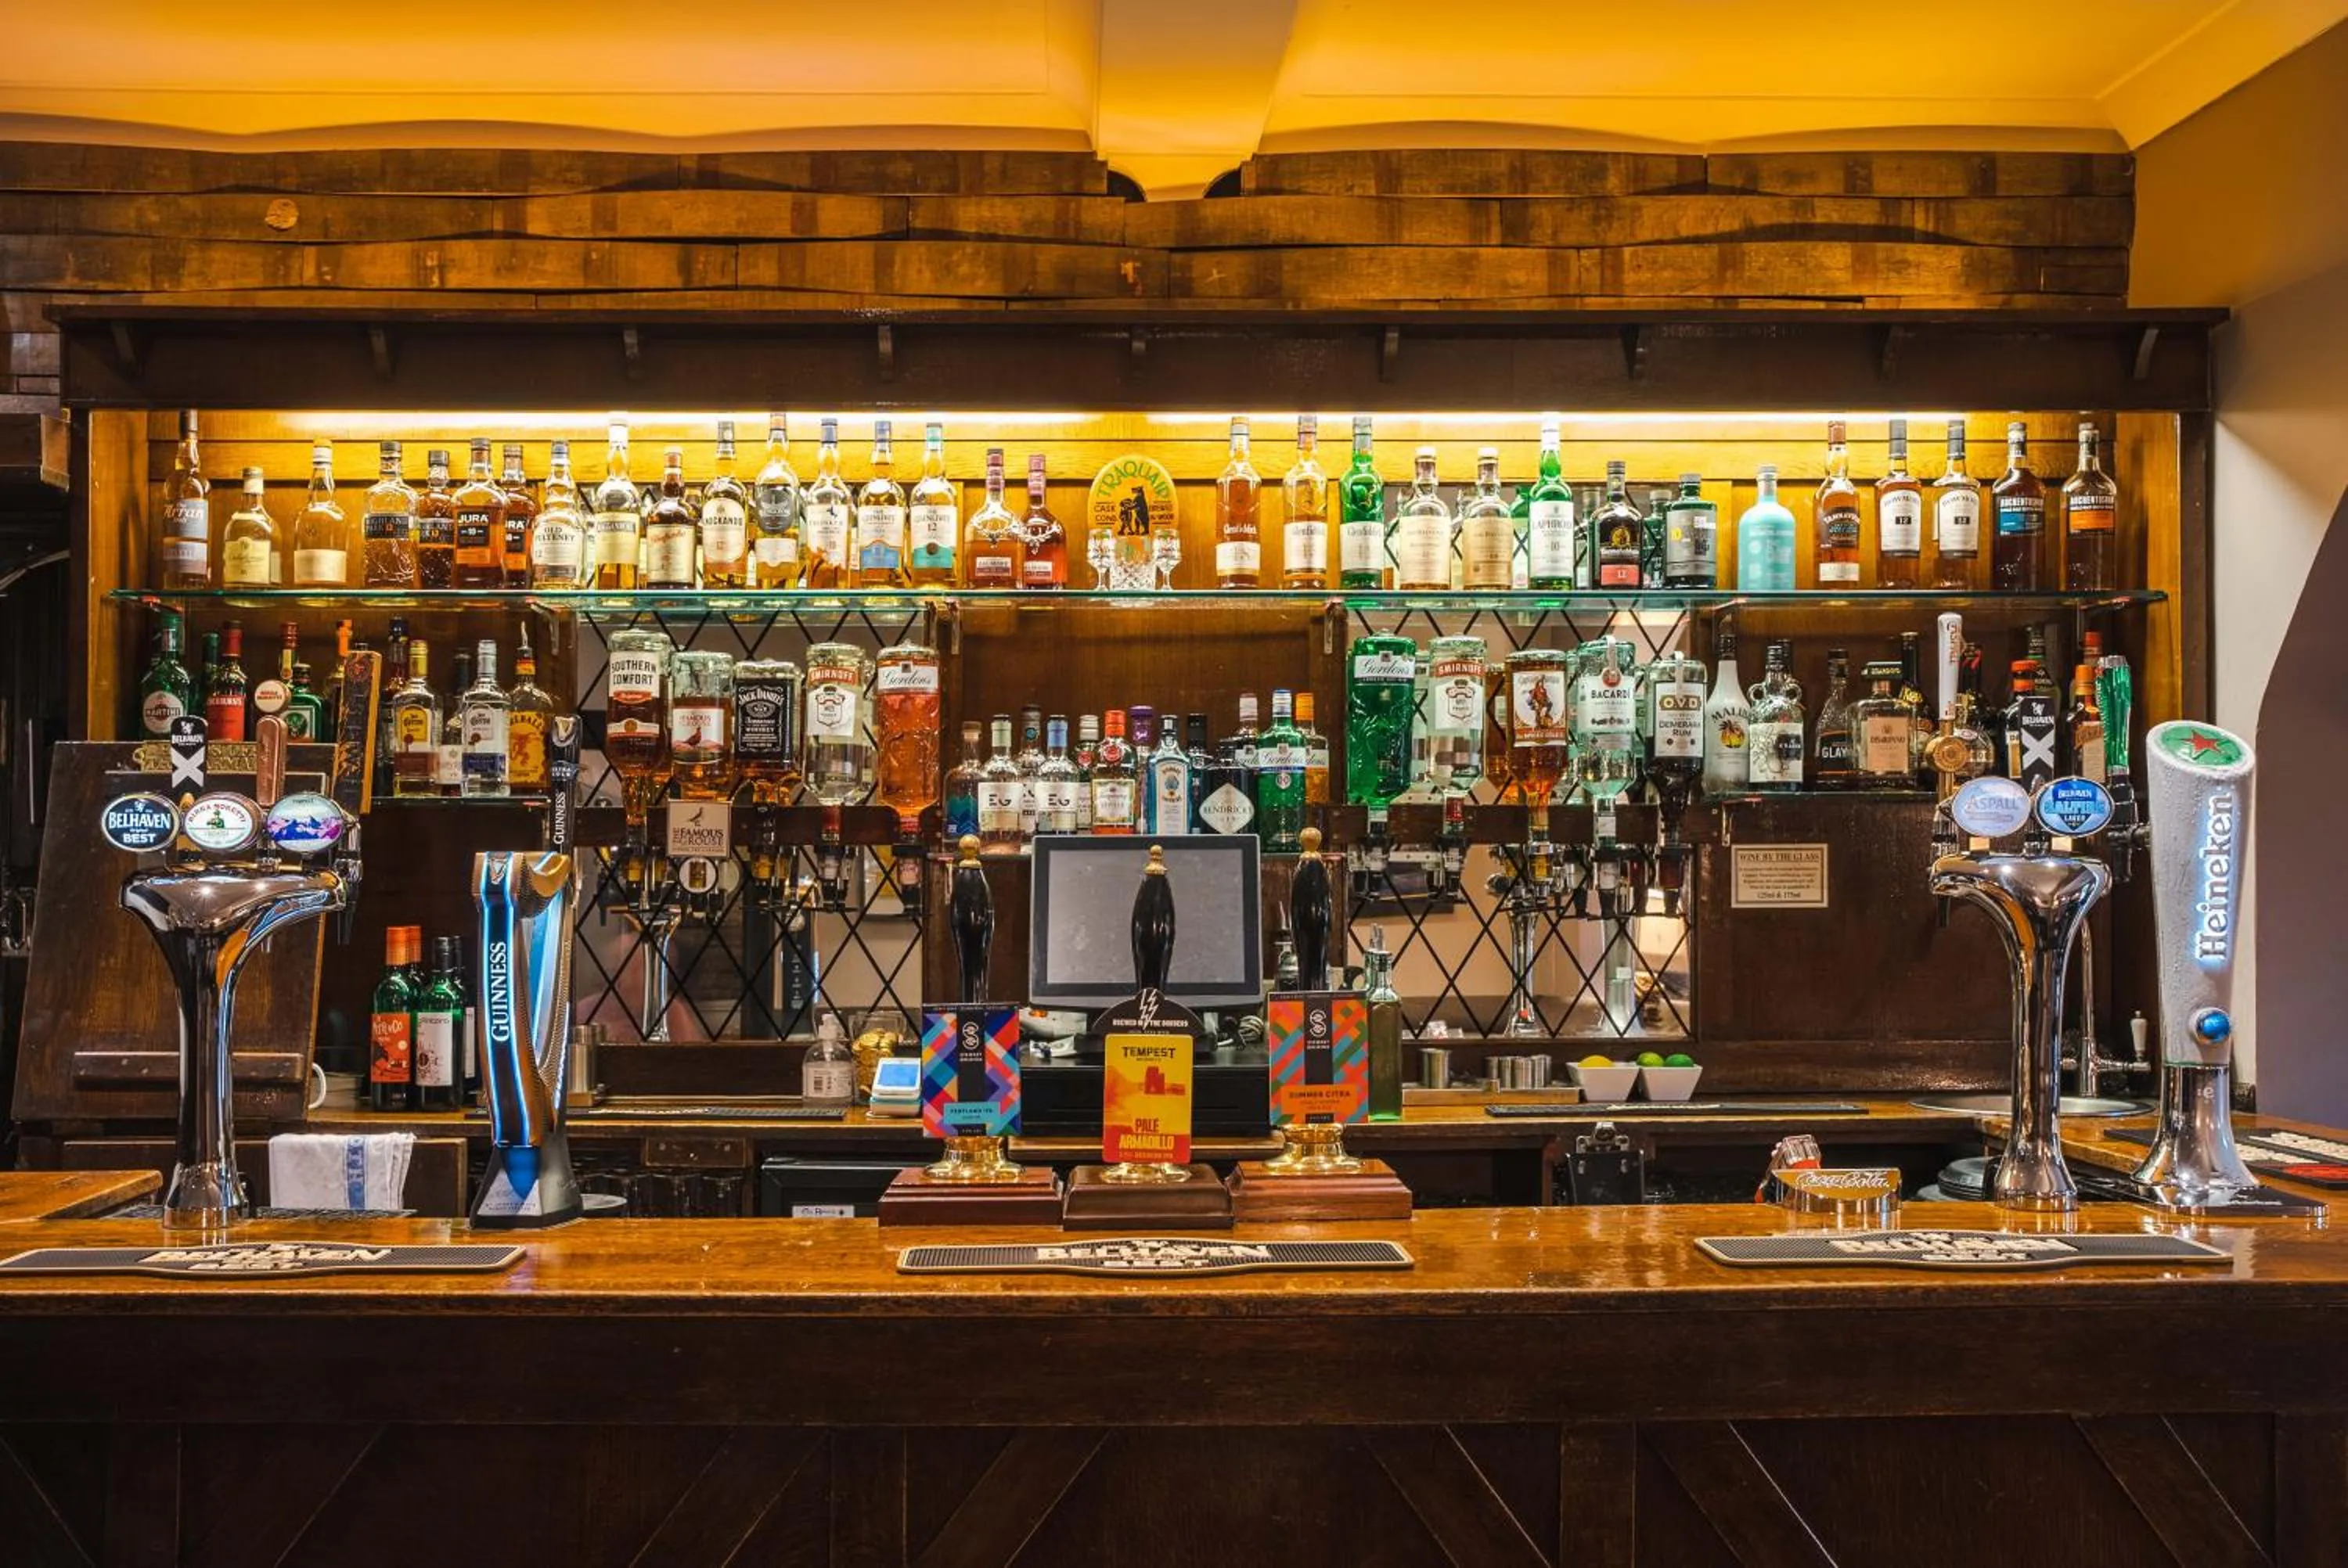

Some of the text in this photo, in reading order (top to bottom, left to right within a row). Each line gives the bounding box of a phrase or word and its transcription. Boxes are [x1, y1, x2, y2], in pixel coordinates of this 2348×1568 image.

[1097, 461, 1171, 498] TRAQUAIR
[458, 513, 489, 524] JURA
[927, 523, 938, 532] 12
[611, 660, 657, 672] SOUTHERN
[1438, 663, 1482, 674] SMIRNOFF
[613, 674, 653, 685] COMFORT
[810, 667, 853, 682] SMIRNOFF
[739, 688, 784, 704] JACK DANIEL'S
[146, 707, 182, 716] MARTINI
[2022, 716, 2054, 725] BELHAVEN
[1673, 728, 1691, 737] RUM
[171, 735, 204, 743] BELHAVEN
[2058, 789, 2092, 798] BELHAVEN
[1966, 795, 2018, 811] ASPALL
[213, 804, 246, 822] MORETTI
[553, 791, 566, 844] GUINNESS
[108, 812, 171, 829] BELHAVEN
[123, 833, 157, 843] BEST
[680, 828, 724, 839] FAMOUS
[1793, 853, 1820, 861] GLASS
[2194, 793, 2235, 961] Heineken
[490, 941, 509, 1042] GUINNESS
[1122, 1046, 1176, 1059] TEMPEST
[1135, 1118, 1159, 1132] PALE
[1118, 1135, 1175, 1149] ARMADILLO
[1036, 1245, 1271, 1260] BELHAVEN
